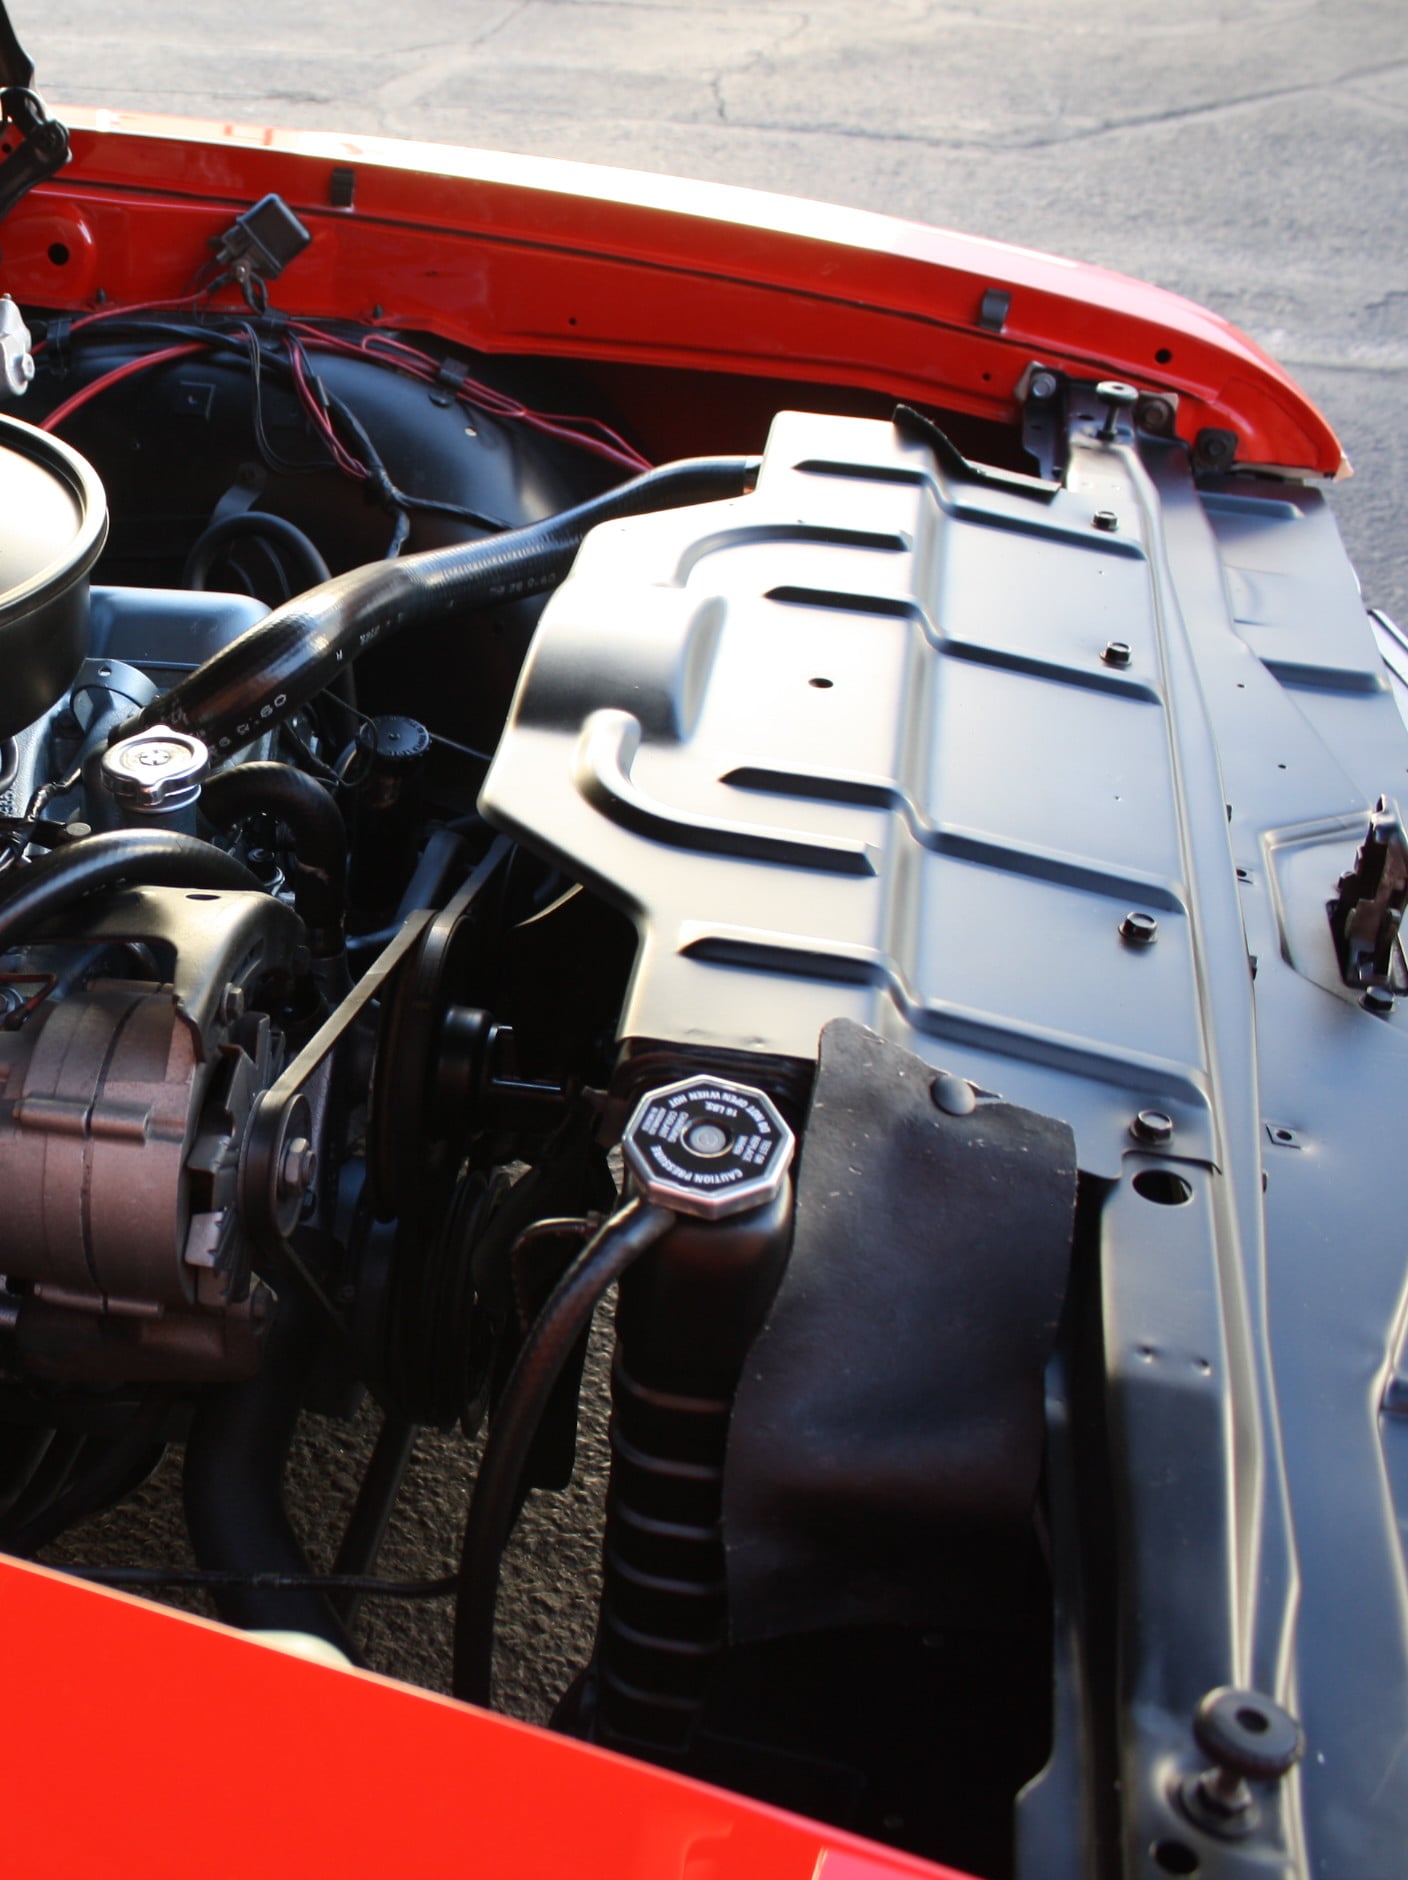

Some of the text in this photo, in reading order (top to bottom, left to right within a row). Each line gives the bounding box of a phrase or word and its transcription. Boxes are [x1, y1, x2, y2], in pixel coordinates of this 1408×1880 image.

[668, 1090, 772, 1134] DO NOT OPEN WHEN HOT
[650, 1144, 744, 1185] CAUTION PRESSURE
